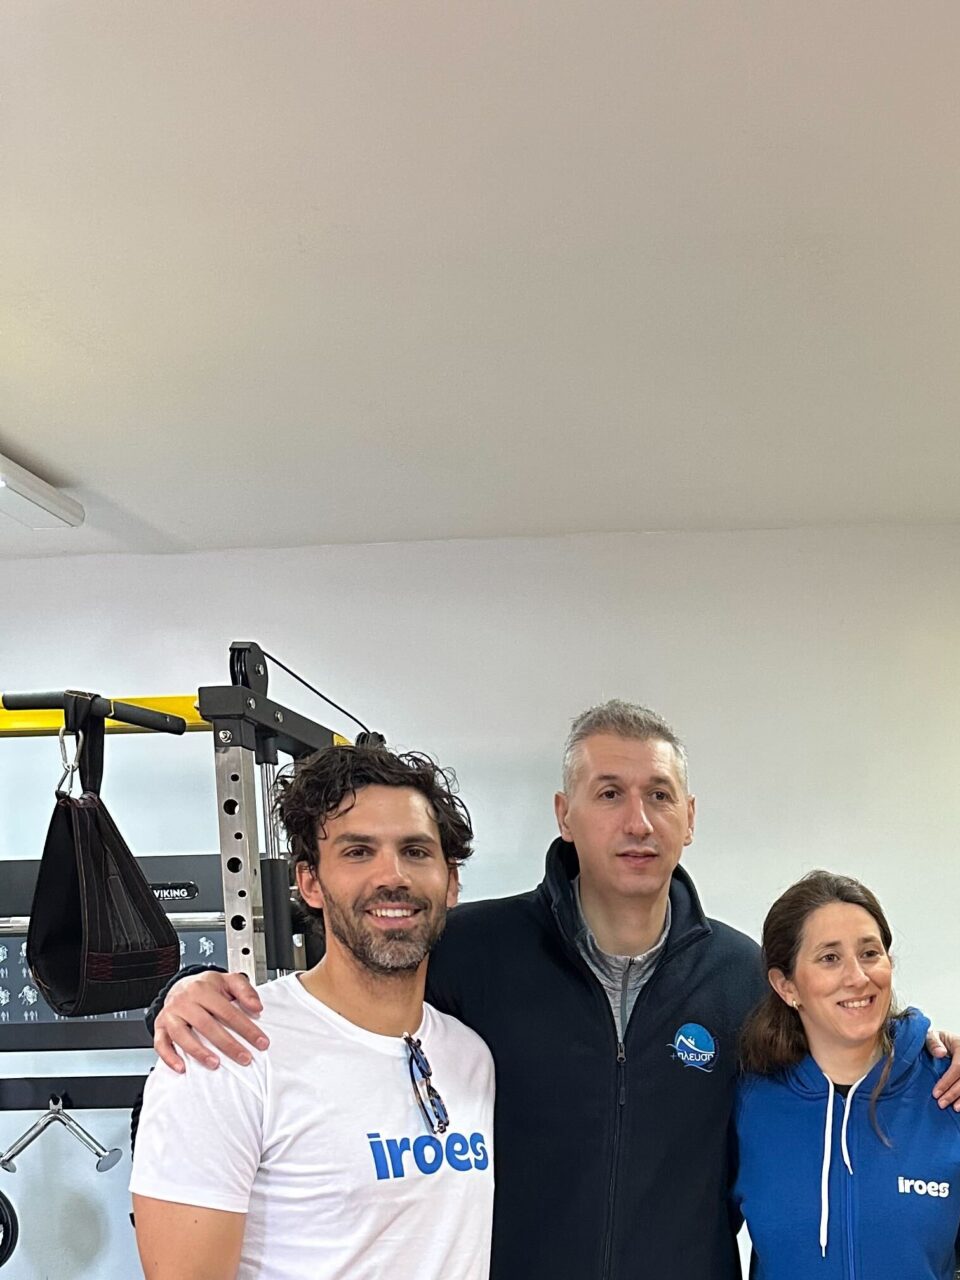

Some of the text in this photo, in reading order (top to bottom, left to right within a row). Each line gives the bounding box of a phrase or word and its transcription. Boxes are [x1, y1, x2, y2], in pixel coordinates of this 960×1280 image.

[153, 889, 188, 898] VIKING
[366, 1132, 489, 1181] iroes
[897, 1176, 950, 1198] iroes
